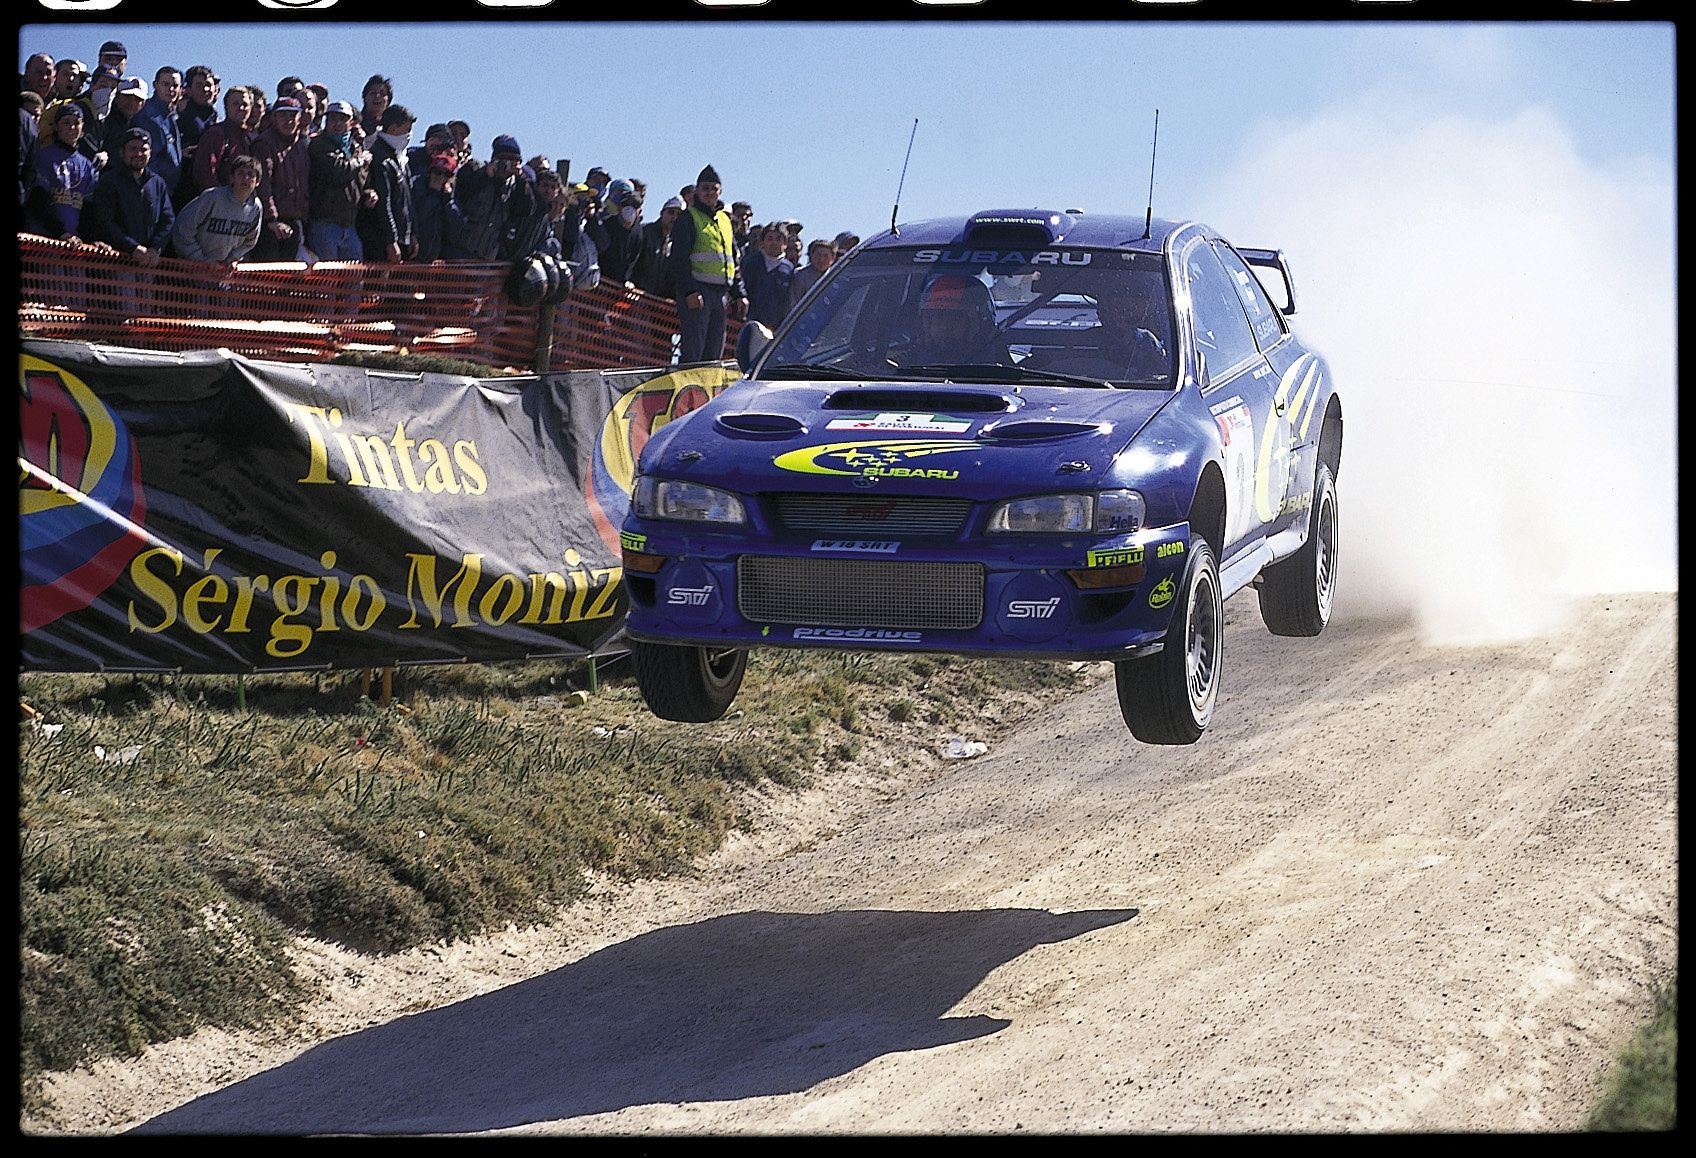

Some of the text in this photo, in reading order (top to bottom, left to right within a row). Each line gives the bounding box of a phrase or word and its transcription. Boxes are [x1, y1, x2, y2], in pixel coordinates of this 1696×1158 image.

[974, 216, 1045, 226] www.swrt.com
[912, 249, 1092, 266] SUBARU
[288, 404, 489, 496] Tintas
[863, 467, 960, 480] SUBARU
[1157, 541, 1185, 558] alcon
[128, 548, 624, 658] Sérgio Moniz
[793, 627, 923, 640] prodrive
